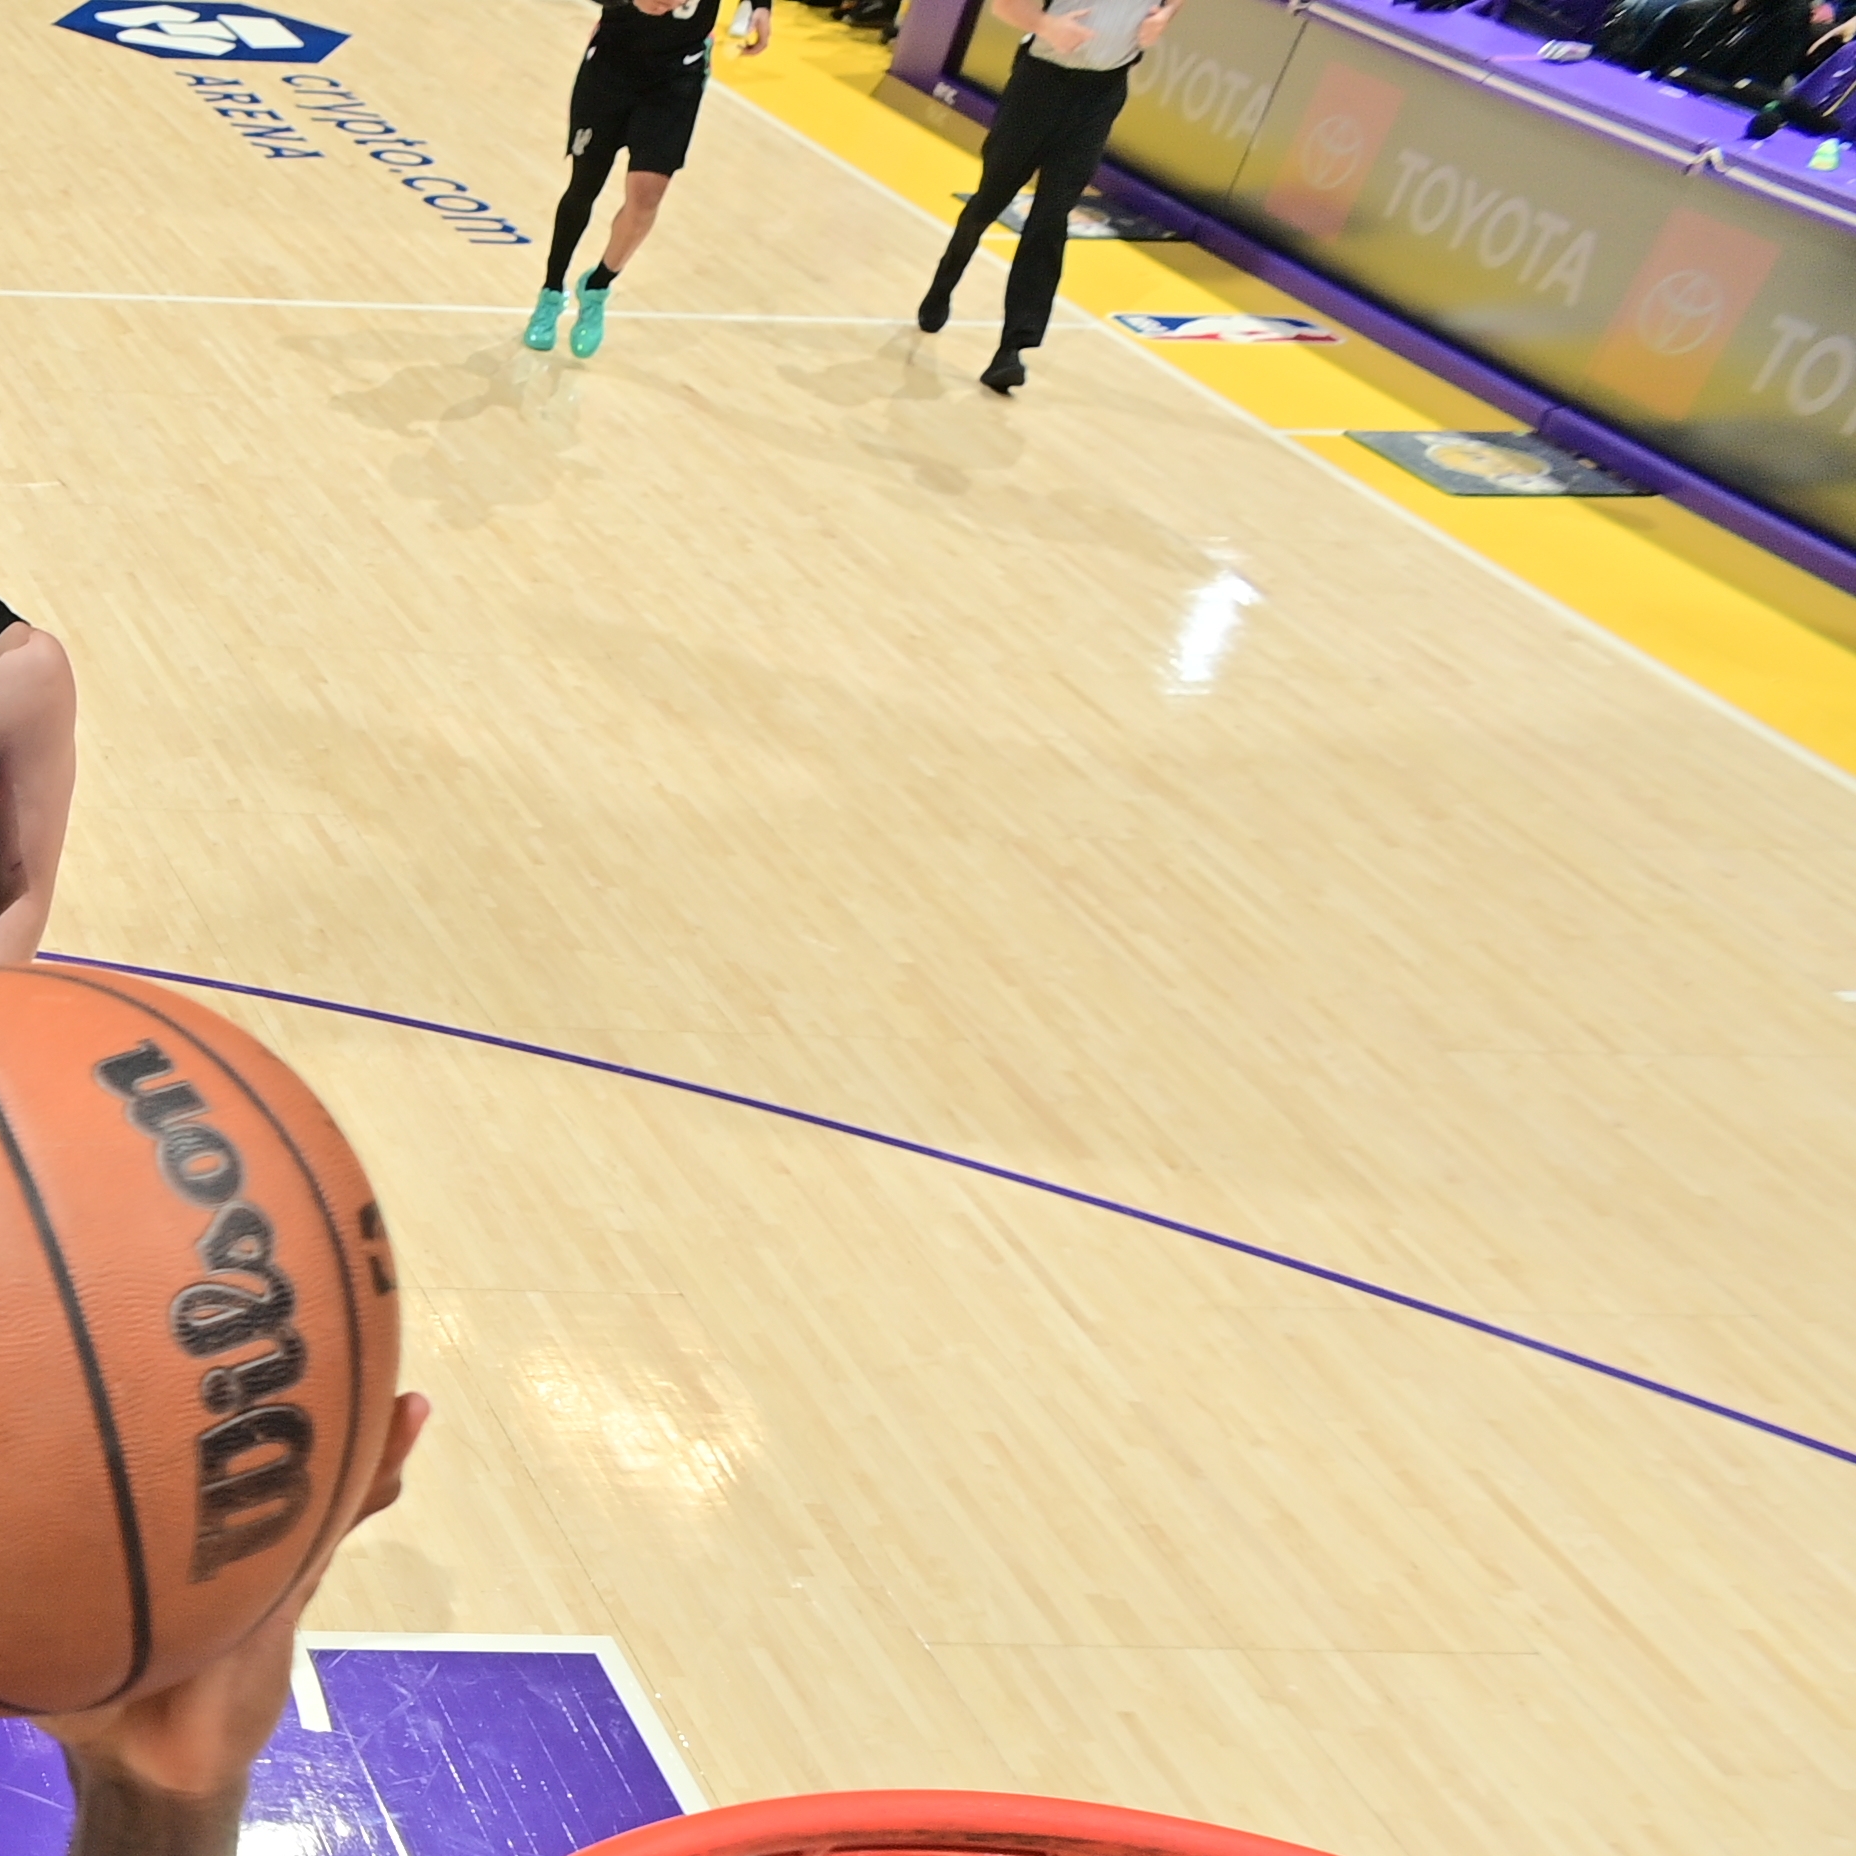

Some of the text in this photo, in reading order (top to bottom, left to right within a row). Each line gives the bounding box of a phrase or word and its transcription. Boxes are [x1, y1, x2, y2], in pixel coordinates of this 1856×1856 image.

[174, 71, 325, 159] ARENA
[281, 74, 532, 245] crypto.com
[1129, 38, 1274, 141] OYOTA
[1384, 148, 1599, 308] TOYOTA
[94, 1038, 315, 1584] Wilson
